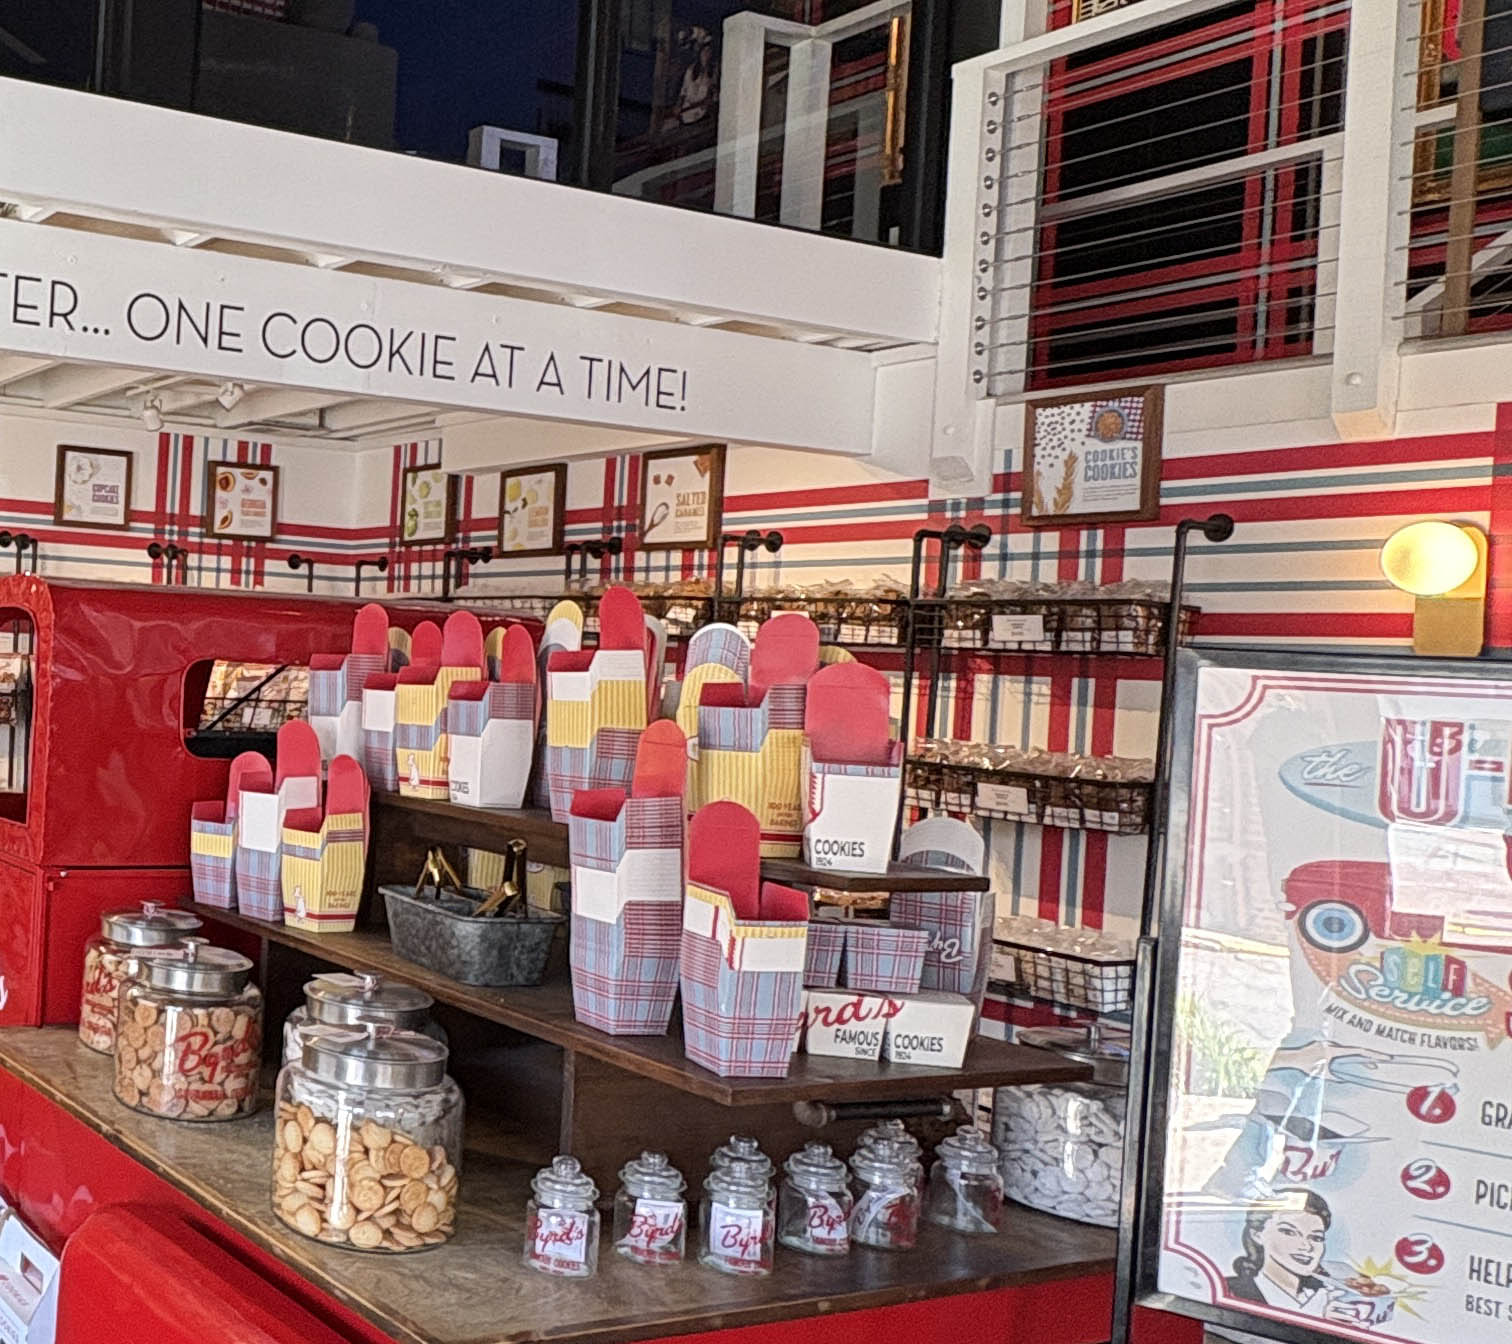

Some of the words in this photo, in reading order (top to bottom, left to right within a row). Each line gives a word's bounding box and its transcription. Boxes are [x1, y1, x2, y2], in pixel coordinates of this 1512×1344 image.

[126, 291, 244, 354] ONE
[260, 311, 457, 382] COOKIE
[469, 340, 521, 394] AT
[538, 349, 565, 397] A
[579, 353, 688, 412] TIME!
[1084, 446, 1138, 464] COOKIE'S
[1084, 462, 1138, 482] COOKIES
[1300, 747, 1373, 784] the
[814, 839, 865, 858] COOKIES
[1340, 961, 1495, 1017] Service
[1323, 1002, 1348, 1023] MIX
[1347, 1015, 1372, 1034] AND
[1374, 1024, 1417, 1046] MATCH
[834, 1028, 880, 1048] FAMOUS
[893, 1033, 944, 1053] COOKIES
[854, 1046, 877, 1058] SINCE
[1464, 1294, 1502, 1319] BEST
